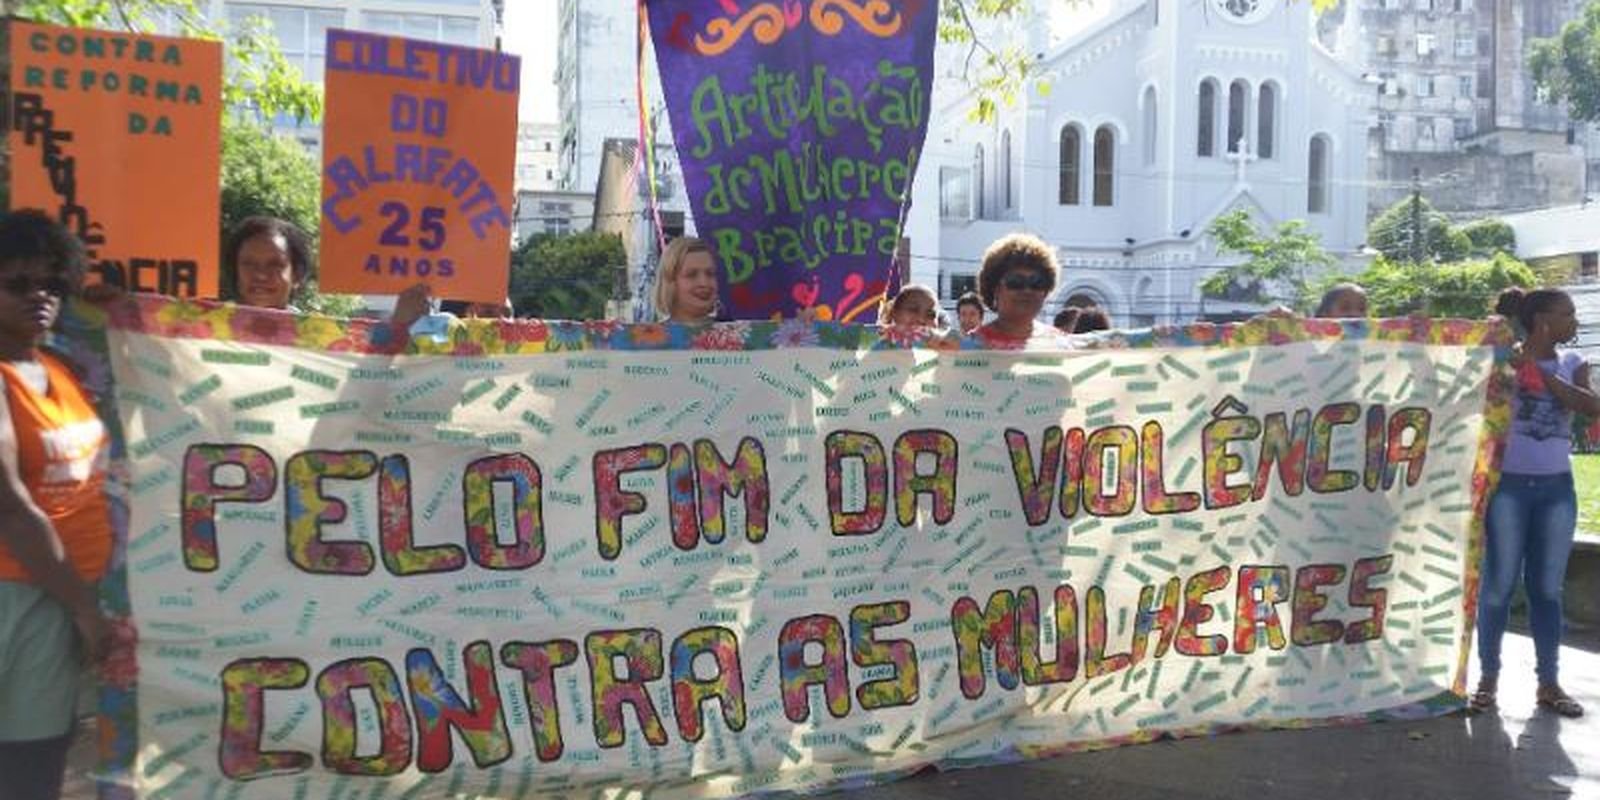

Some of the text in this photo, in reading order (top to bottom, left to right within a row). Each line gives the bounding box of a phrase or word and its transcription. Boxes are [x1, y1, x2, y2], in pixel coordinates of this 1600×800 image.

[29, 33, 182, 65] CONTRA
[325, 28, 521, 92] COLETIVO
[24, 67, 203, 104] REFORMA
[128, 112, 172, 136] DA
[391, 94, 448, 137] DO
[321, 143, 511, 240] CALAFATE
[379, 201, 447, 251] 25
[363, 254, 456, 277] ANOS
[181, 443, 546, 577] PELO
[592, 436, 770, 561] FIM
[824, 428, 959, 537] DA
[1003, 394, 1433, 527] VIOLÊNCIA
[217, 553, 1395, 783] CONTRA AS MULHERES
